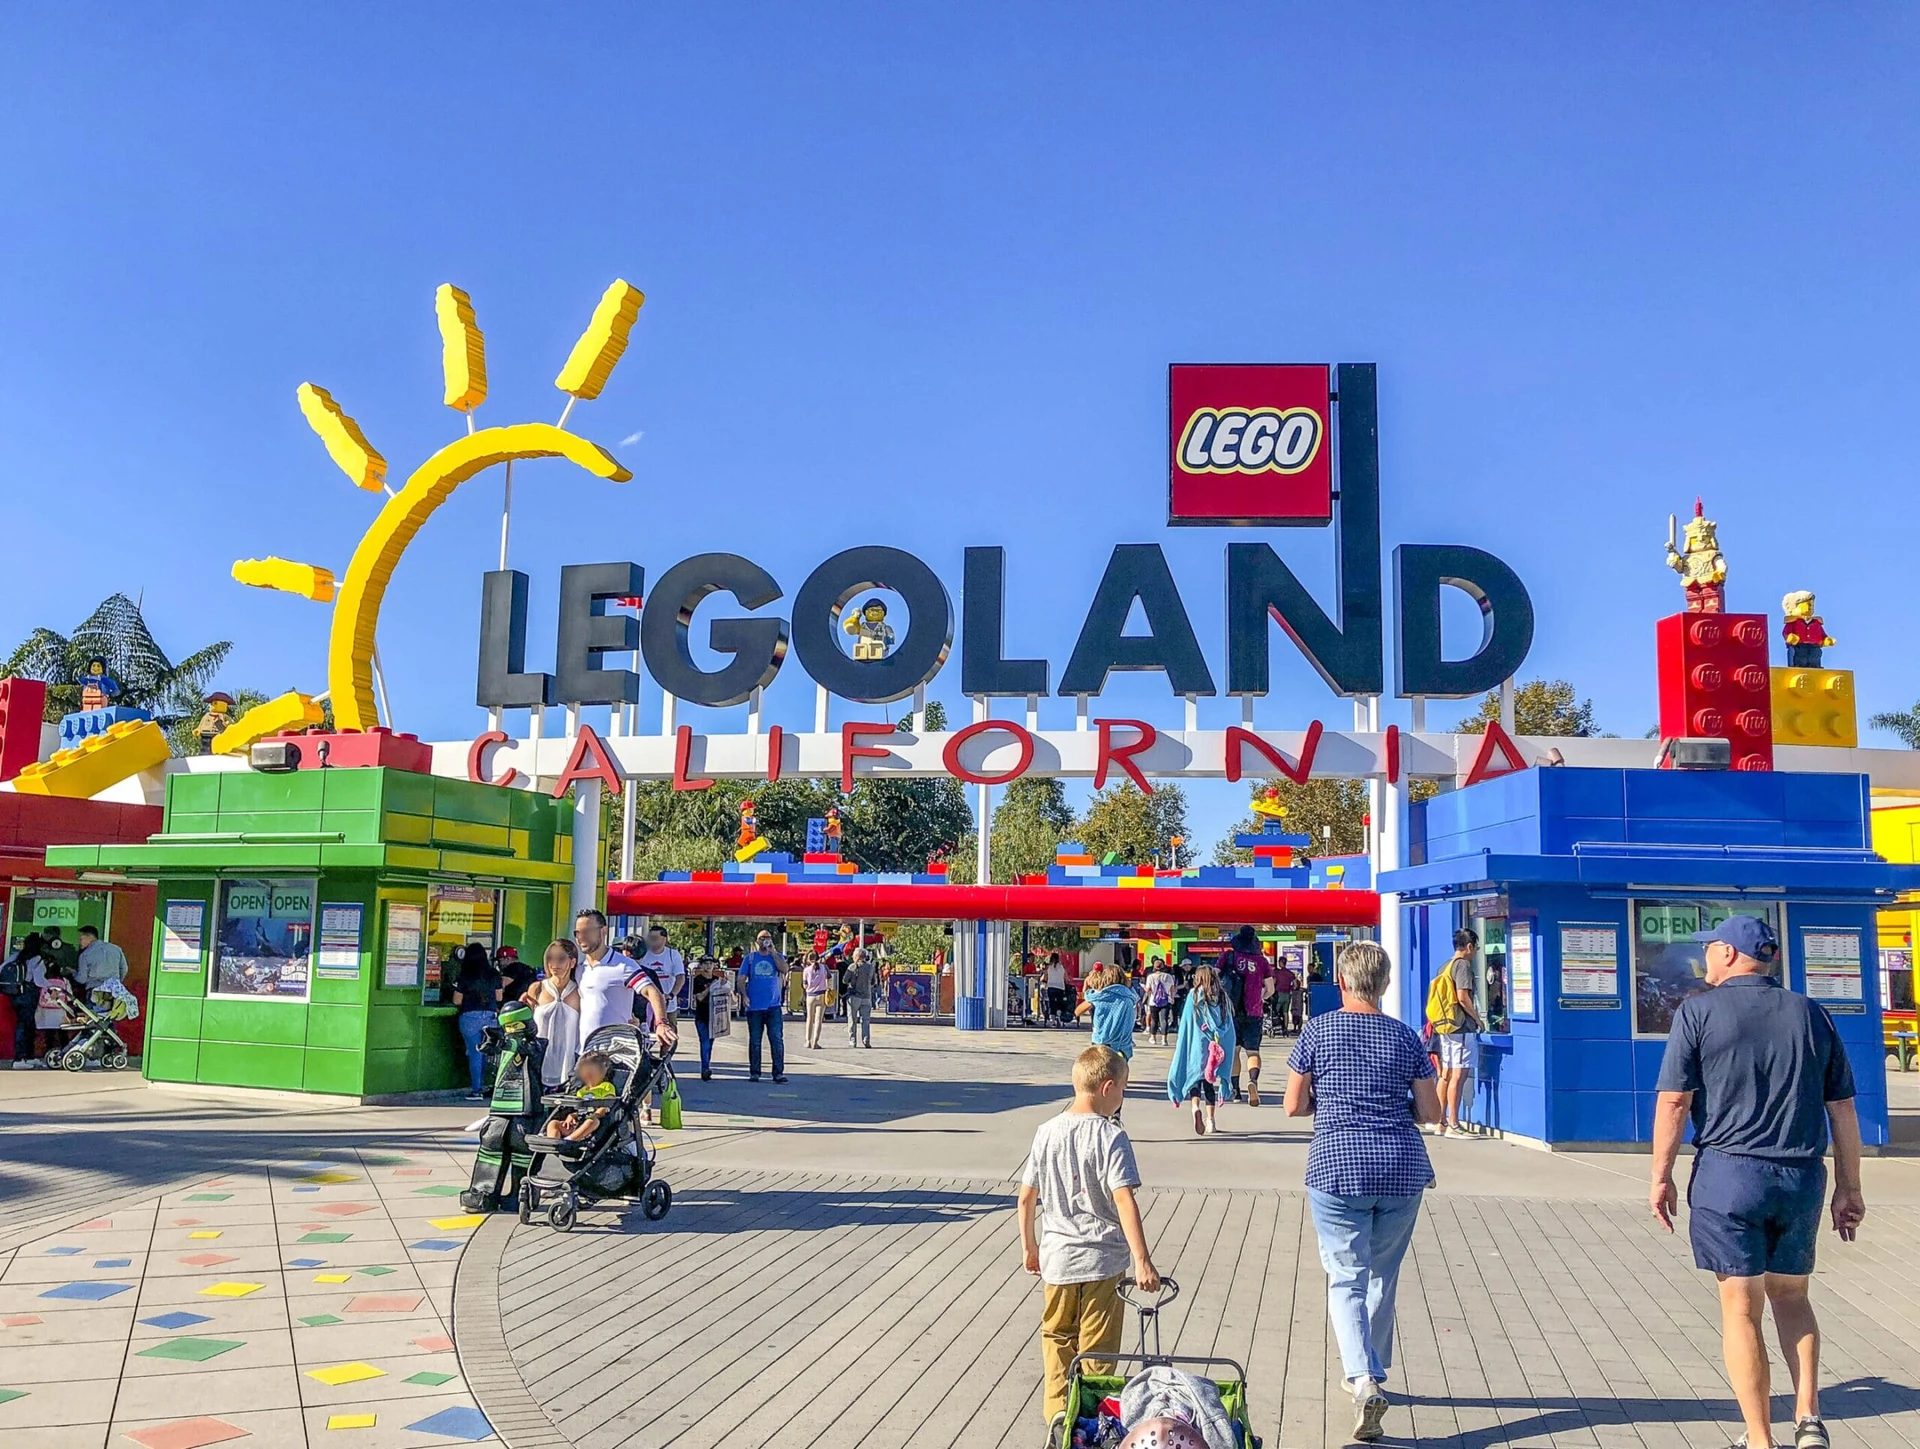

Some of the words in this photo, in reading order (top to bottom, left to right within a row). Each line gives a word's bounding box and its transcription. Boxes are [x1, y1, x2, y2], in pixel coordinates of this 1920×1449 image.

[1183, 412, 1317, 469] LEGO
[468, 717, 1528, 798] CALIFORNIA
[230, 895, 266, 910] OPEN
[274, 896, 310, 911] OPEN
[37, 906, 76, 919] OPEN
[441, 911, 473, 926] OPEN
[1643, 916, 1697, 935] OPEN
